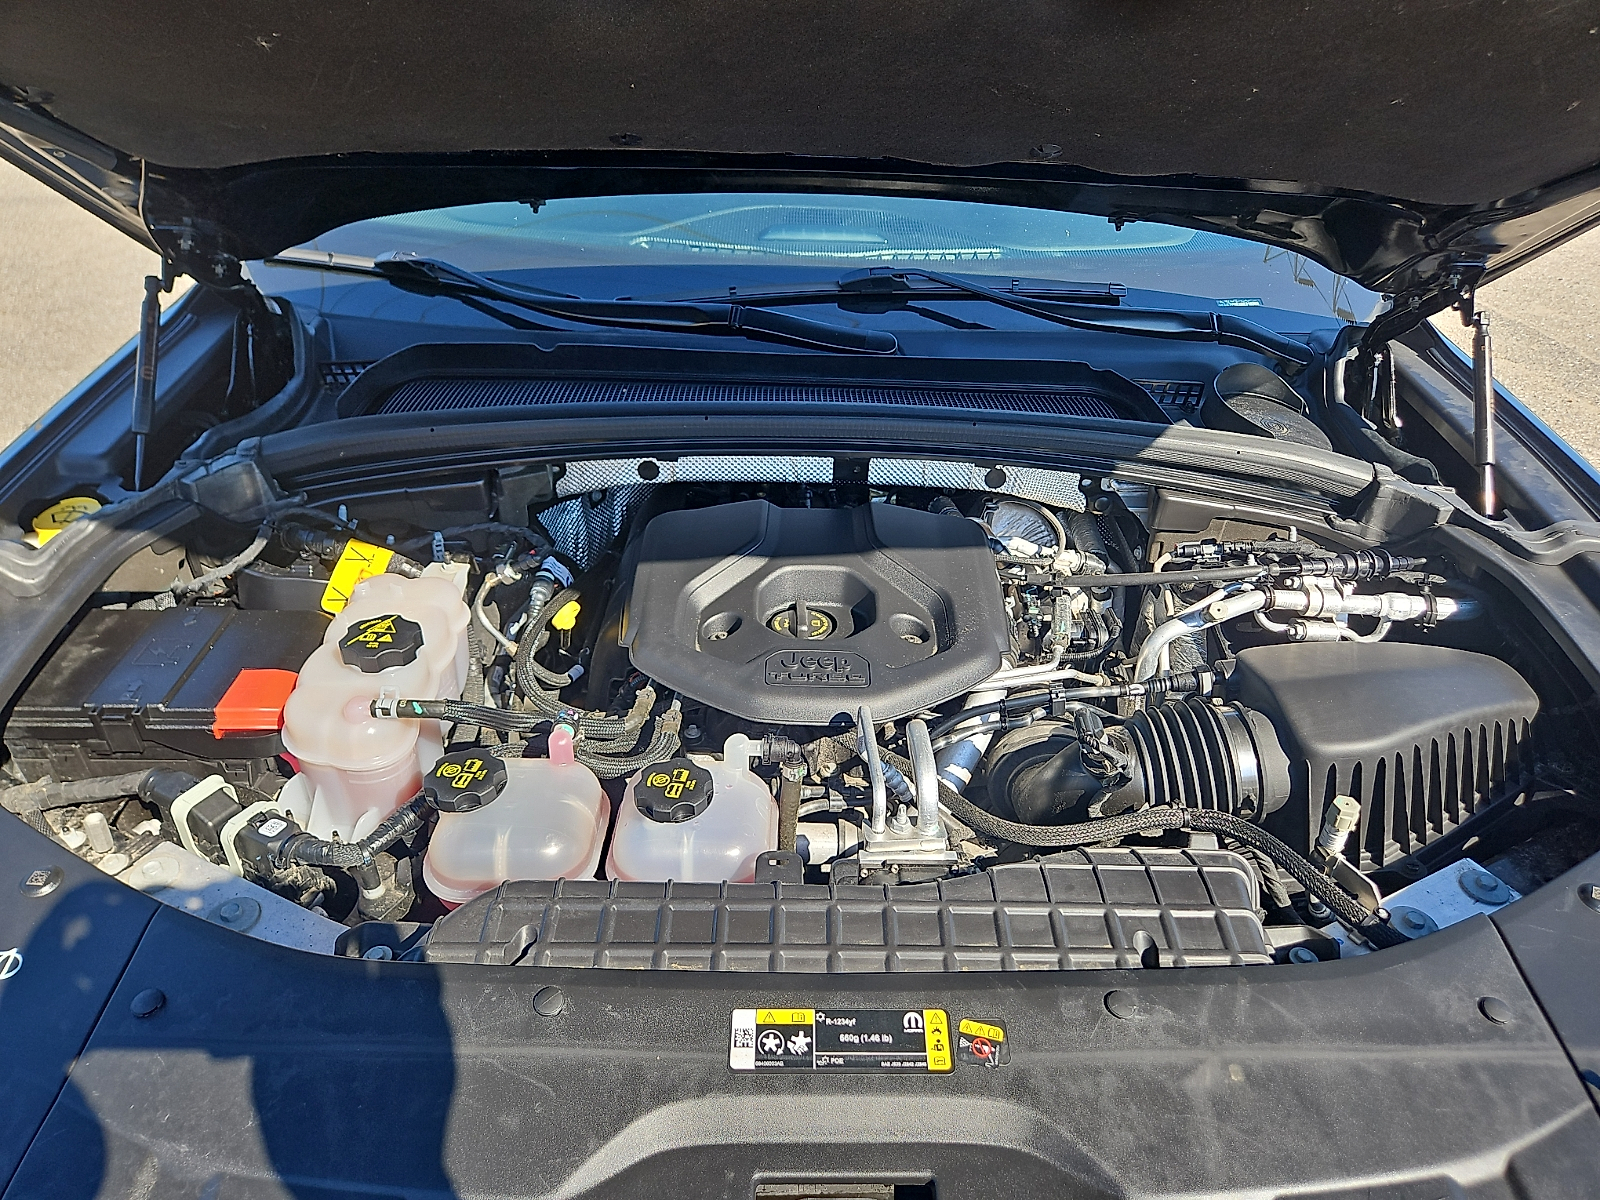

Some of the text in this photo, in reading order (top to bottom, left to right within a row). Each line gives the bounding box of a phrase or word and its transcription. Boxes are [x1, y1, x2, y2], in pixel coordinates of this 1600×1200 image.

[780, 652, 852, 673] Jeep
[825, 1017, 857, 1027] R-1234yf
[881, 1033, 893, 1044] lb)
